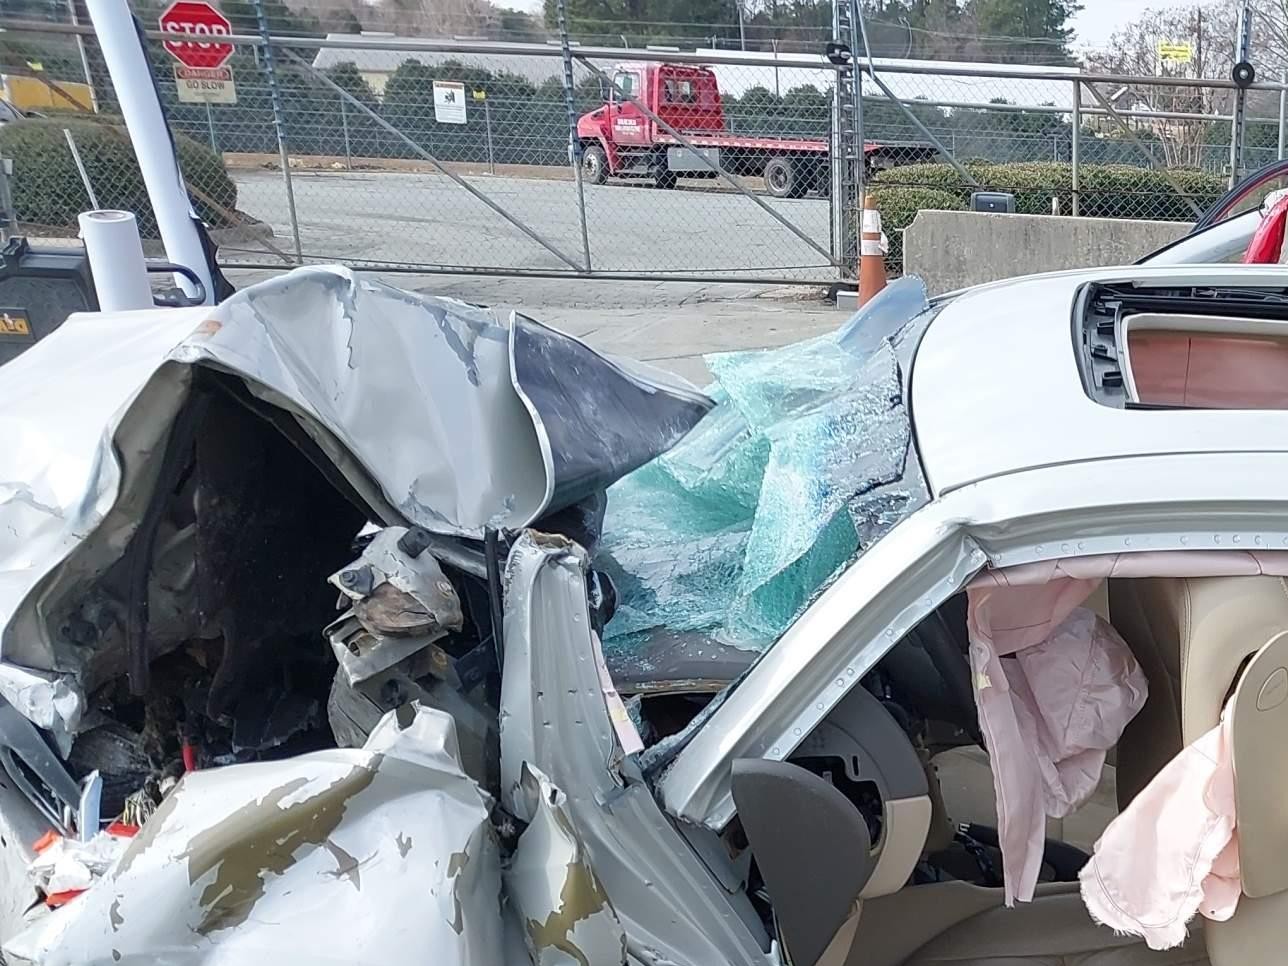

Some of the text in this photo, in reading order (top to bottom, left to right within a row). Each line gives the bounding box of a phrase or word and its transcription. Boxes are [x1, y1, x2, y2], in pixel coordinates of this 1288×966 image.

[166, 22, 226, 48] STOP
[186, 80, 225, 90] GO SLOW
